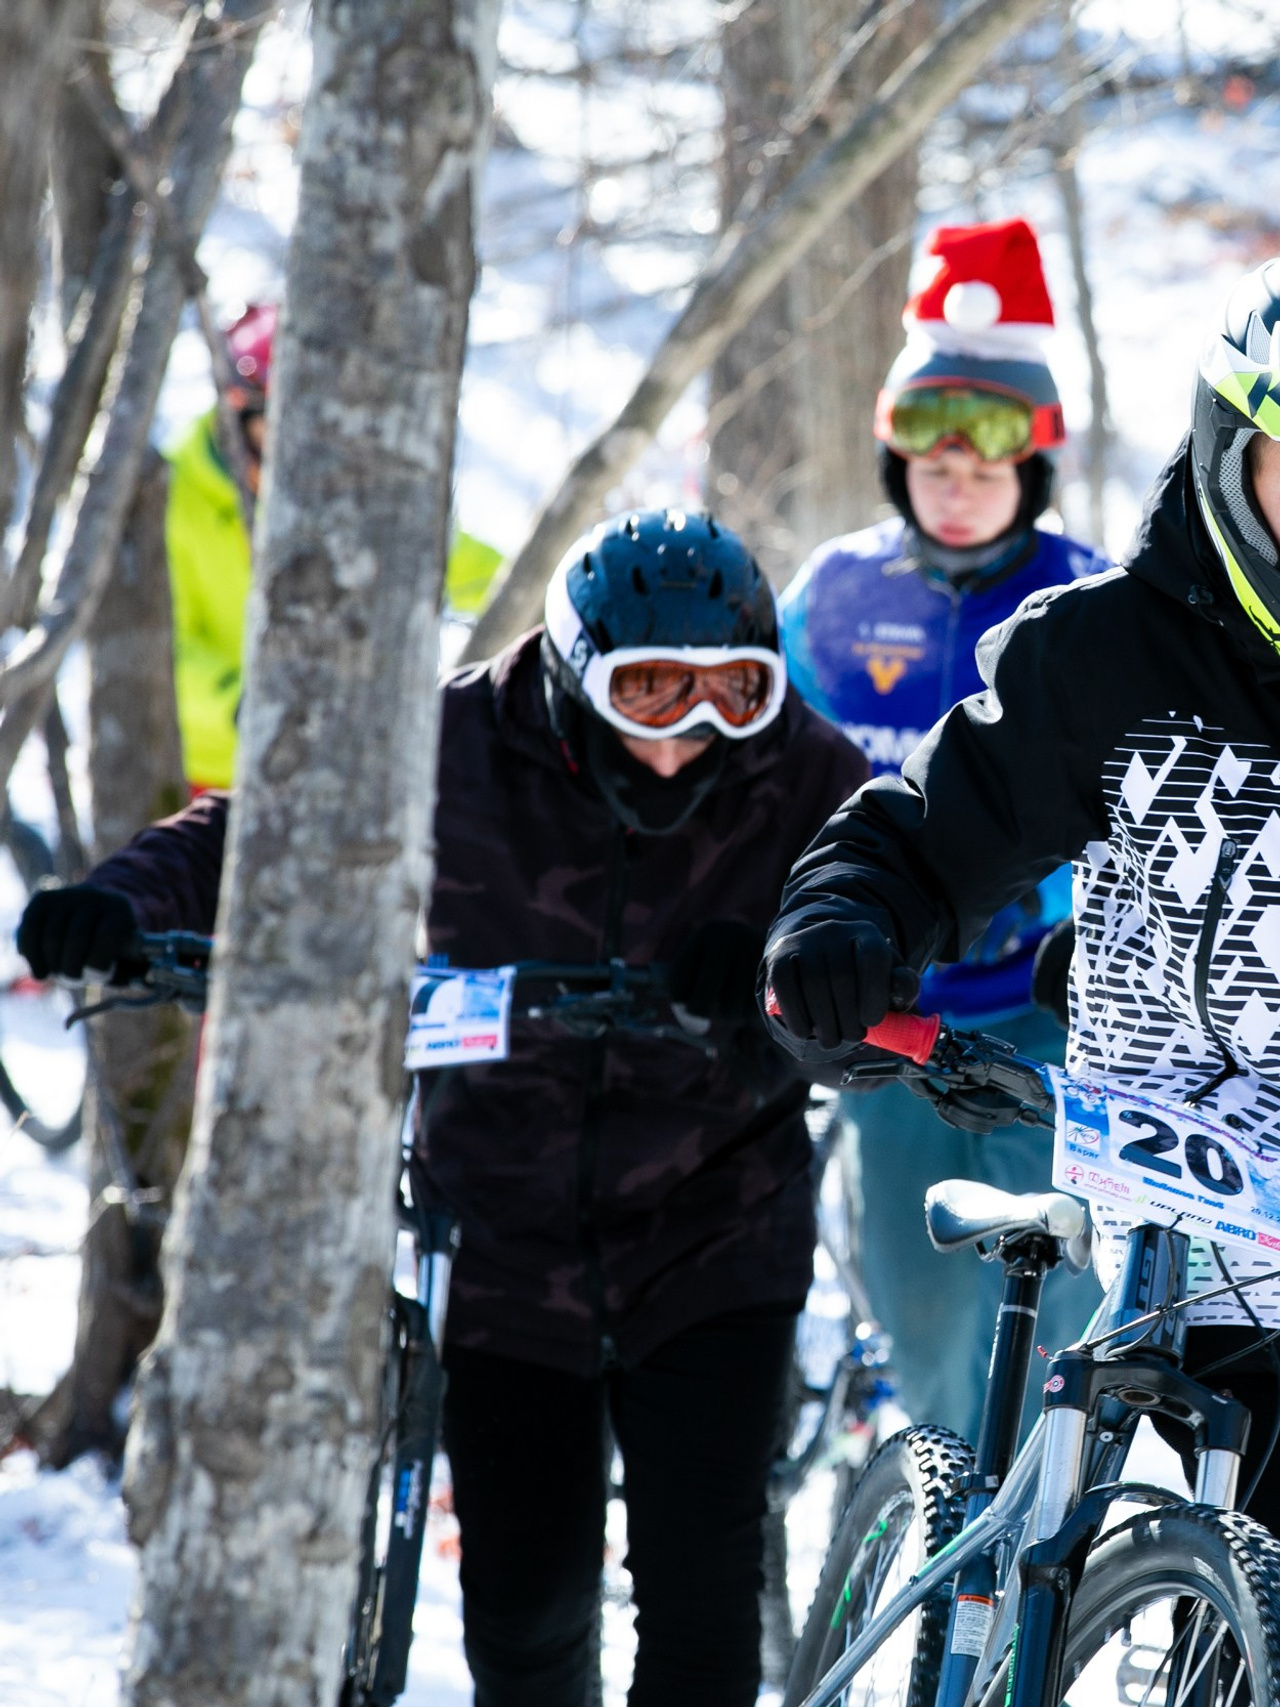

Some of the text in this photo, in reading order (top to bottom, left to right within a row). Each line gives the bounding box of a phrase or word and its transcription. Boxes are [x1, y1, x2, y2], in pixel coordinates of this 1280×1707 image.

[1118, 1110, 1245, 1196] 20
[1150, 1200, 1212, 1224] UPLAND
[1215, 1220, 1256, 1240] ABRO
